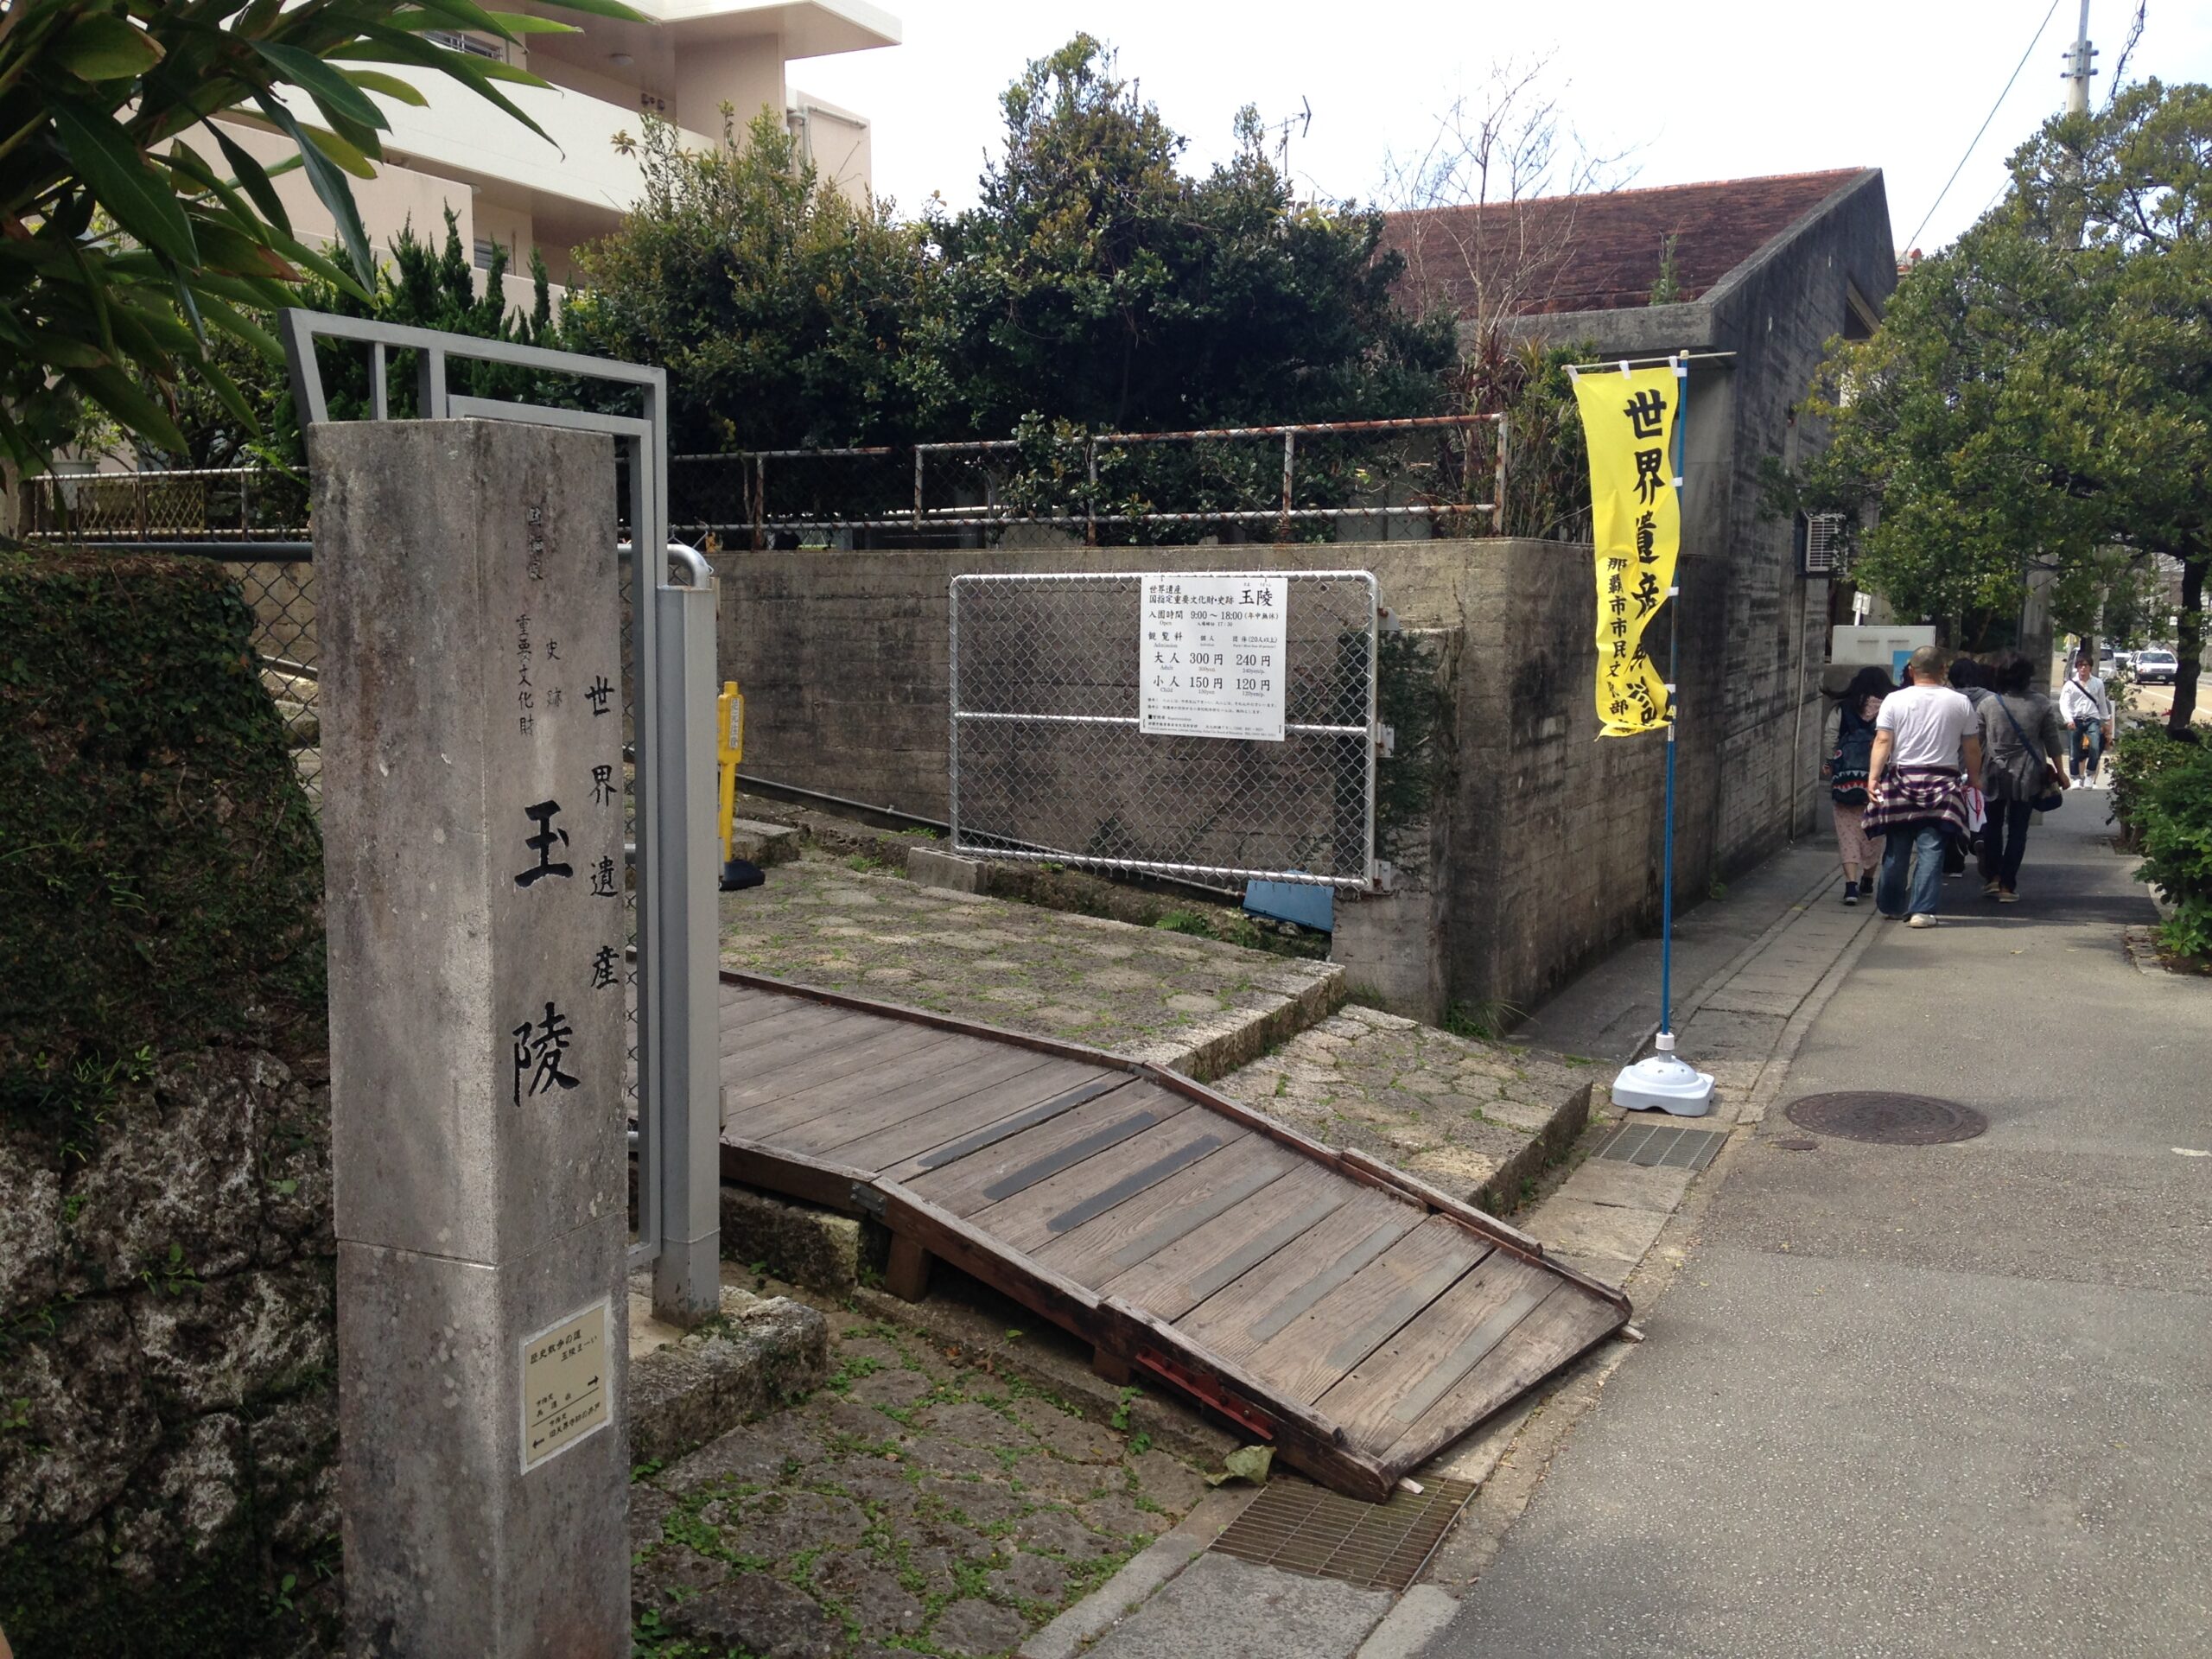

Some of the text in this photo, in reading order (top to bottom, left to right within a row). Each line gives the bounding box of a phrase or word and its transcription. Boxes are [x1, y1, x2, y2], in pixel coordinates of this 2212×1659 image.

[1149, 585, 1182, 594] 世界遺産
[1238, 588, 1273, 607] 玉陵
[1148, 609, 1184, 620] 入園時間
[1190, 610, 1208, 620] 9:00
[1221, 611, 1243, 620] 18:00
[1154, 651, 1180, 664] 大人
[516, 613, 534, 735] 重要文化財
[545, 638, 563, 709] 史跡
[1153, 675, 1180, 688] 小人
[584, 675, 620, 990] 世界遺産
[512, 800, 582, 1108] 玉陵
